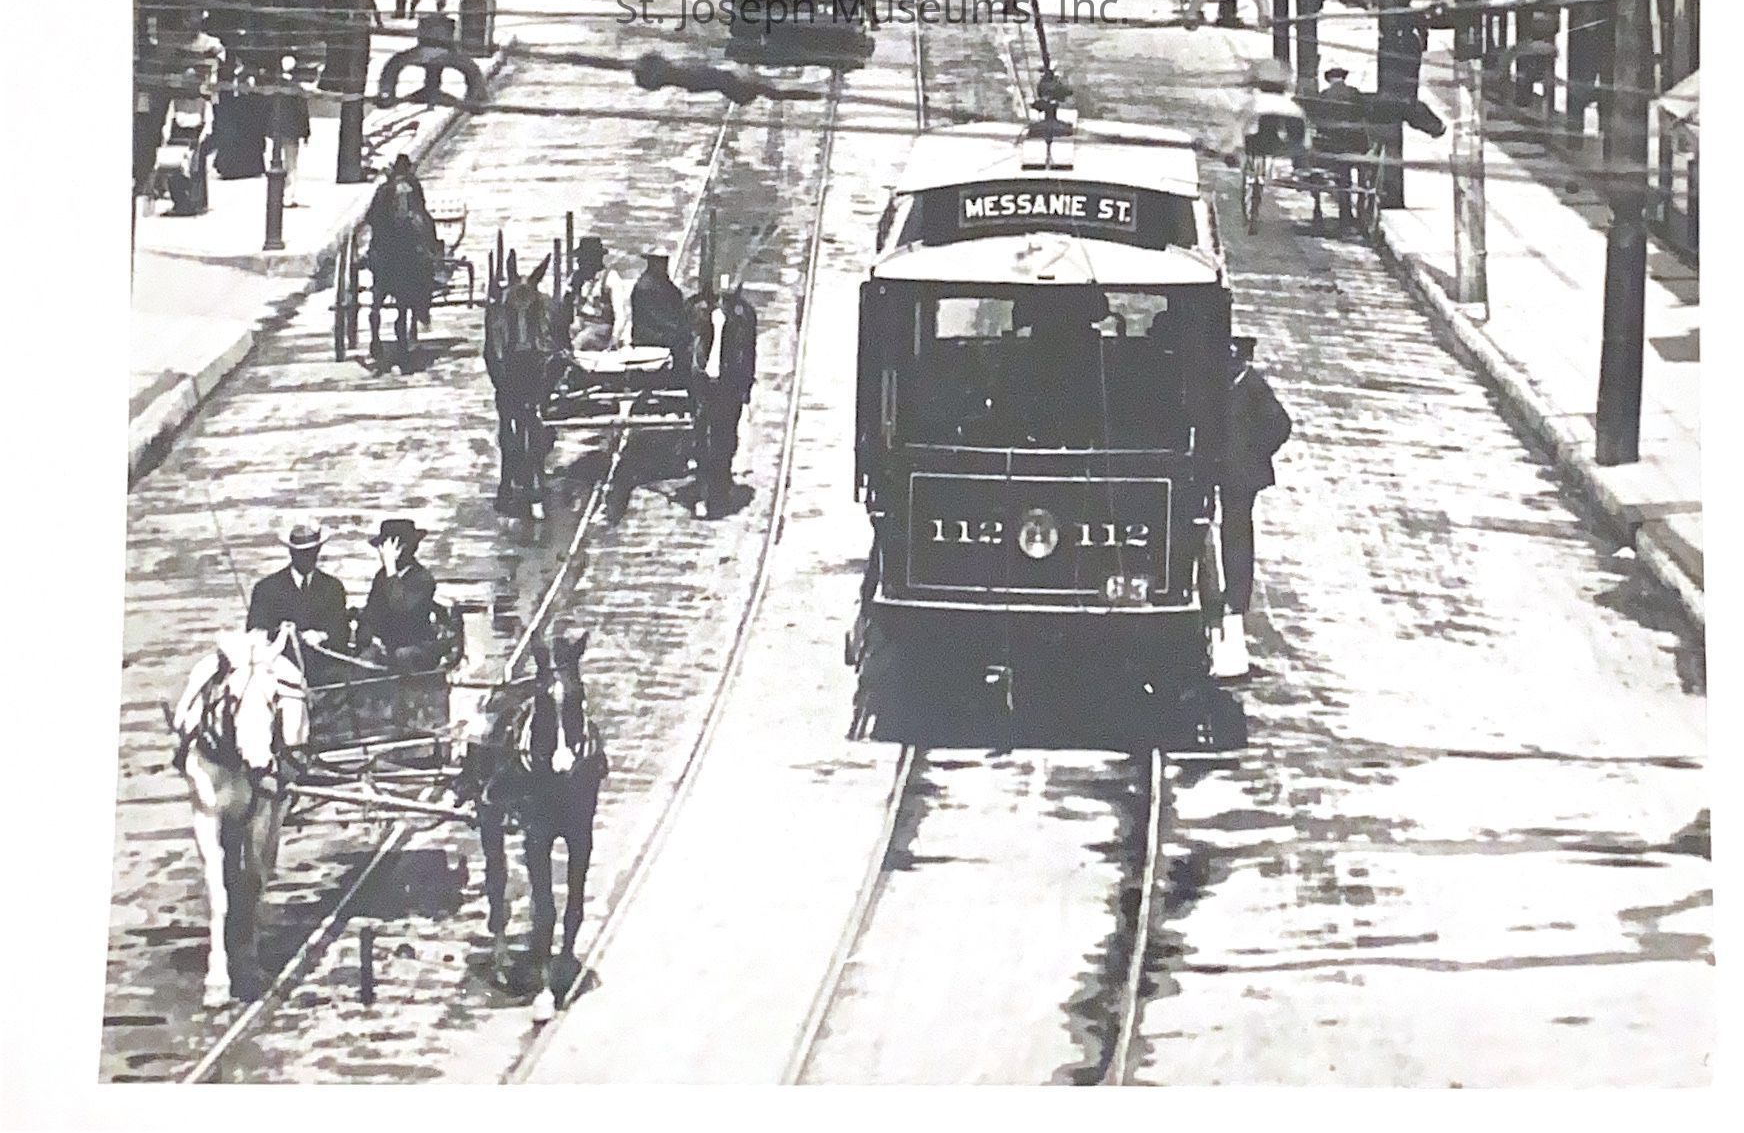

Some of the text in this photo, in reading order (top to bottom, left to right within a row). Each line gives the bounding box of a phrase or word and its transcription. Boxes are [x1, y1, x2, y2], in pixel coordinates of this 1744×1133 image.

[965, 194, 1131, 222] MESSANIE ST.
[928, 519, 1149, 546] 112 112
